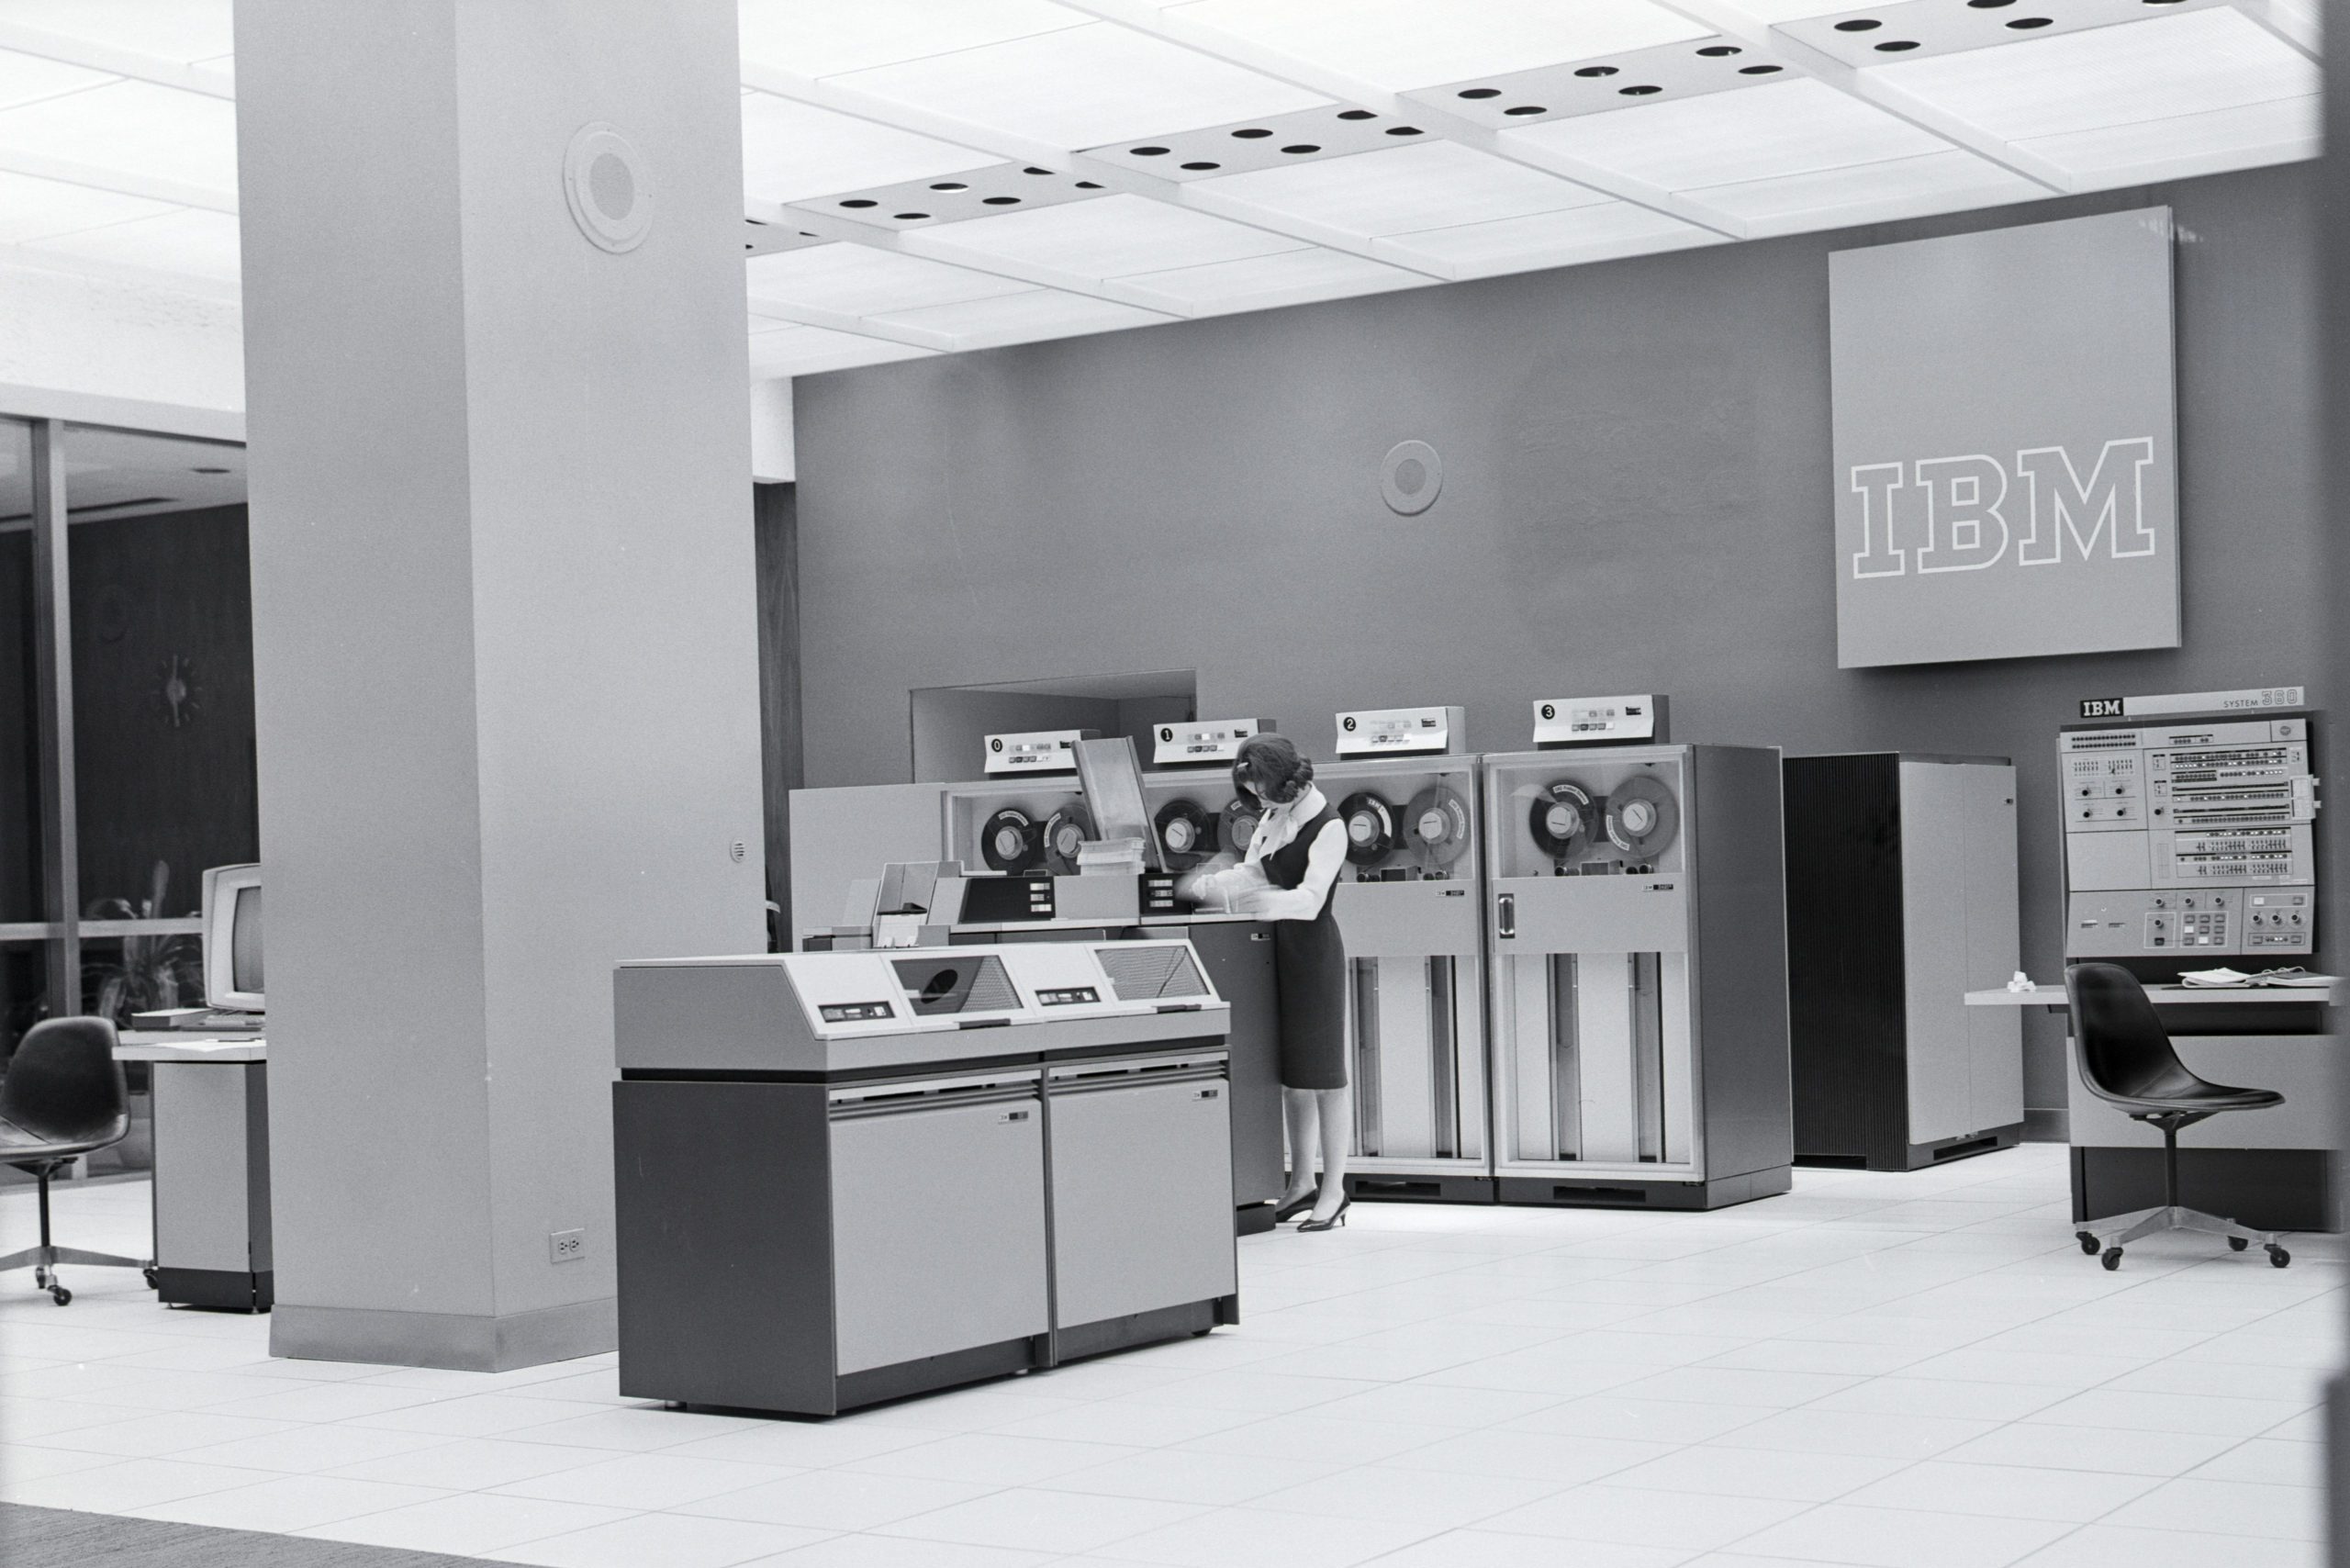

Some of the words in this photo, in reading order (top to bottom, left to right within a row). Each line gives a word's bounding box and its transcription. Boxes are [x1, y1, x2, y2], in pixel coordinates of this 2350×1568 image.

[1851, 436, 2155, 579] IBM
[2083, 700, 2120, 716] IBM
[2223, 700, 2258, 709] SYSTEM
[2262, 689, 2298, 706] 360
[1545, 706, 1553, 717] 3
[1347, 719, 1354, 729] 2
[1164, 730, 1170, 740] 1
